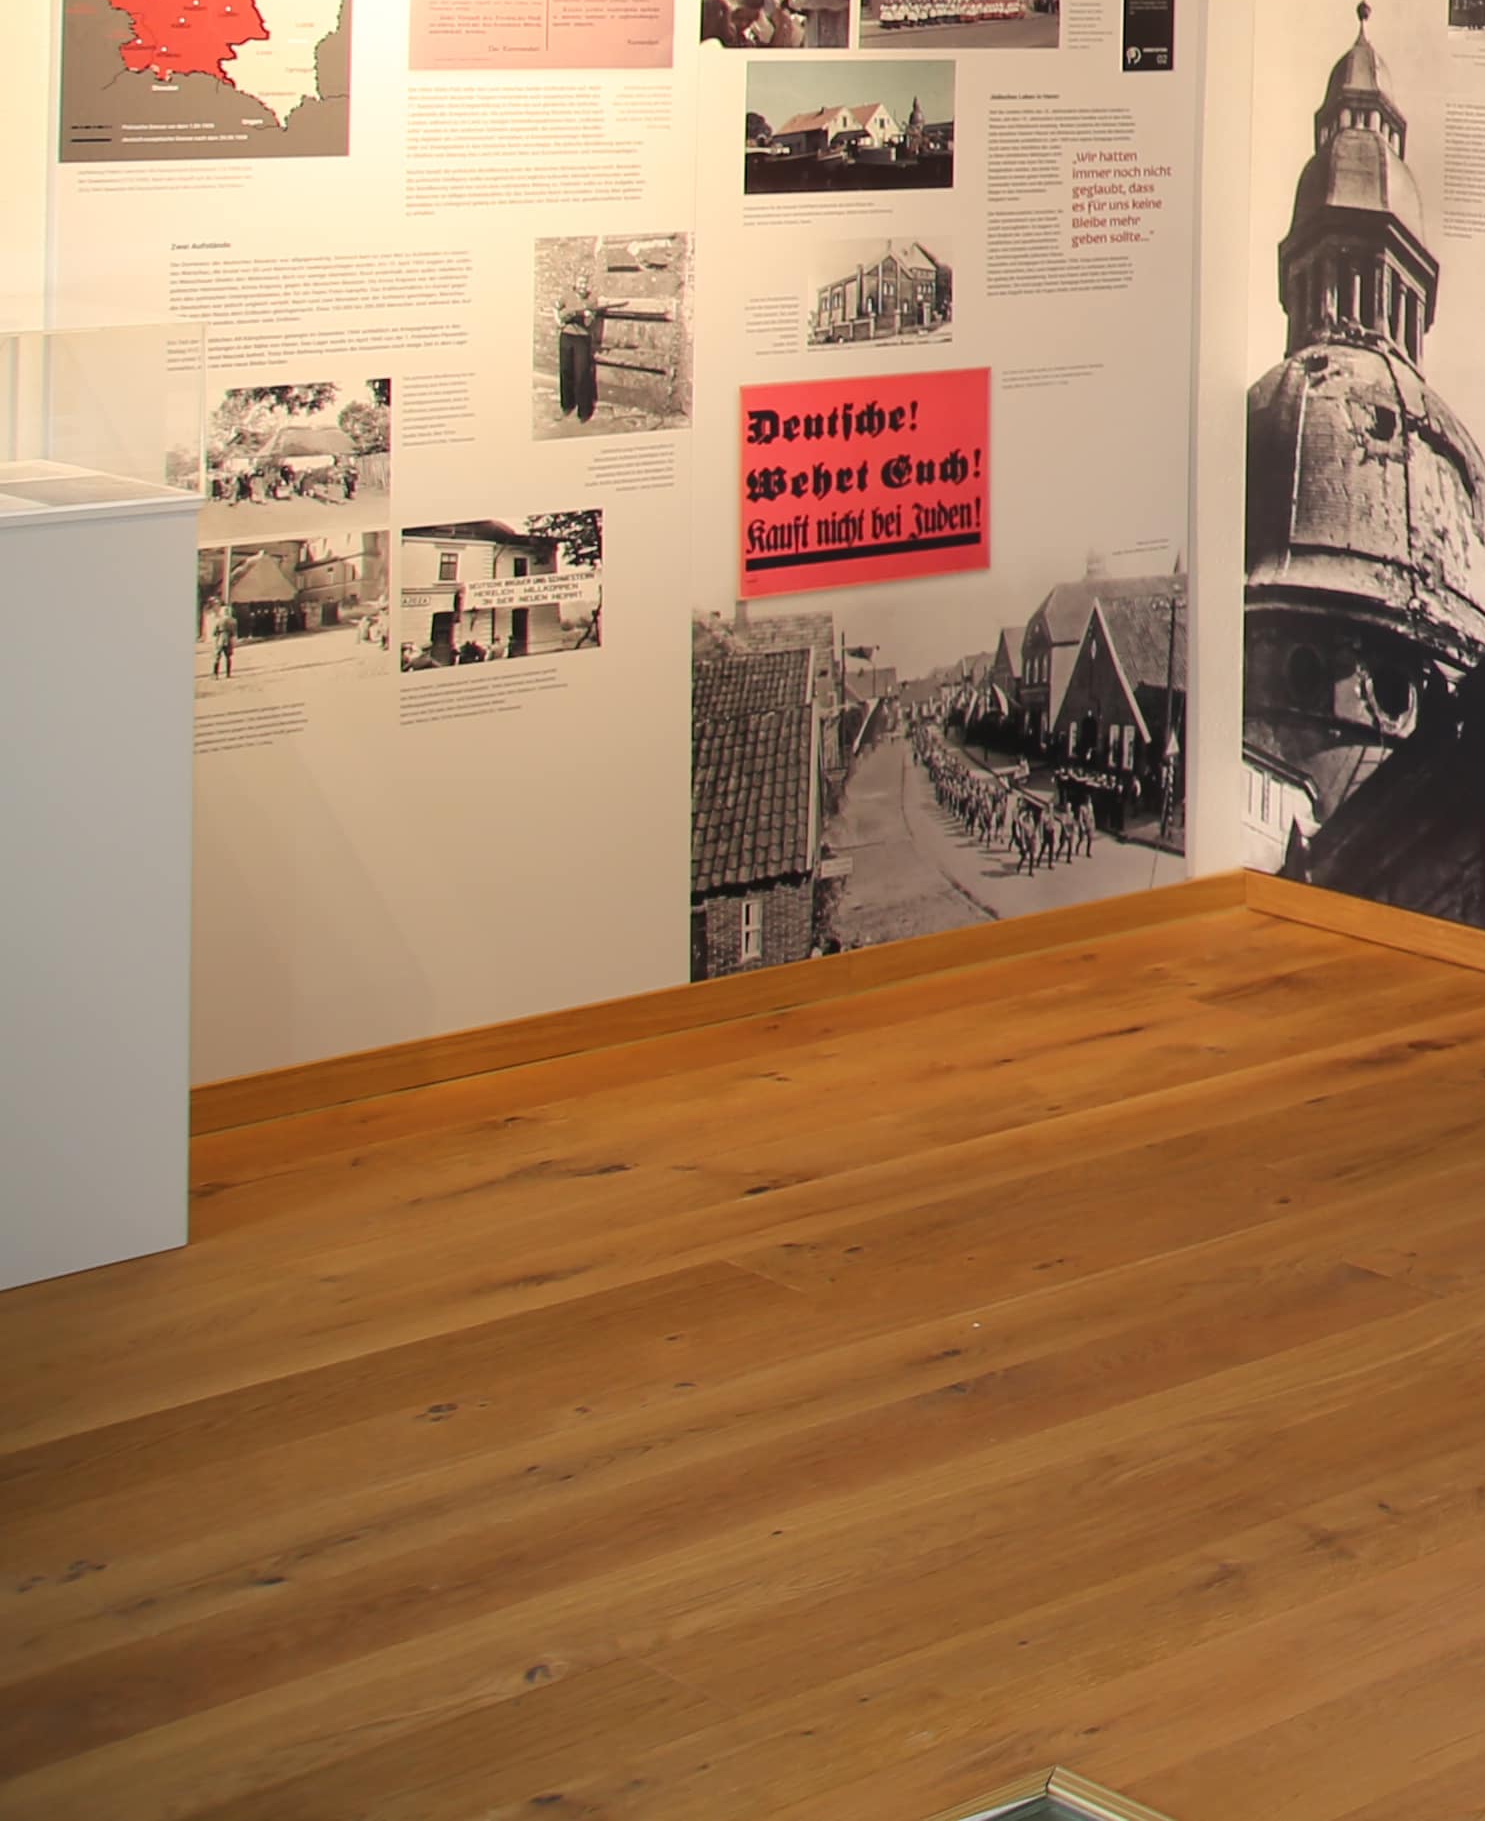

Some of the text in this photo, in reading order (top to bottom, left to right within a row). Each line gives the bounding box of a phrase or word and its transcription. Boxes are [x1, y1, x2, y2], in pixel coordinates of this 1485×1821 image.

[1099, 151, 1137, 162] hatten
[1072, 165, 1171, 179] immer noch nicht
[1072, 182, 1154, 199] geglaubt, dass
[1072, 198, 1162, 214] es für uns keine
[1072, 215, 1140, 228] Bleibe mehr
[1071, 233, 1107, 248] geben
[747, 400, 917, 444] Deutsche!
[746, 448, 981, 502] Wehrt Euch!
[746, 497, 981, 553] Kauft nicht bei Juden!
